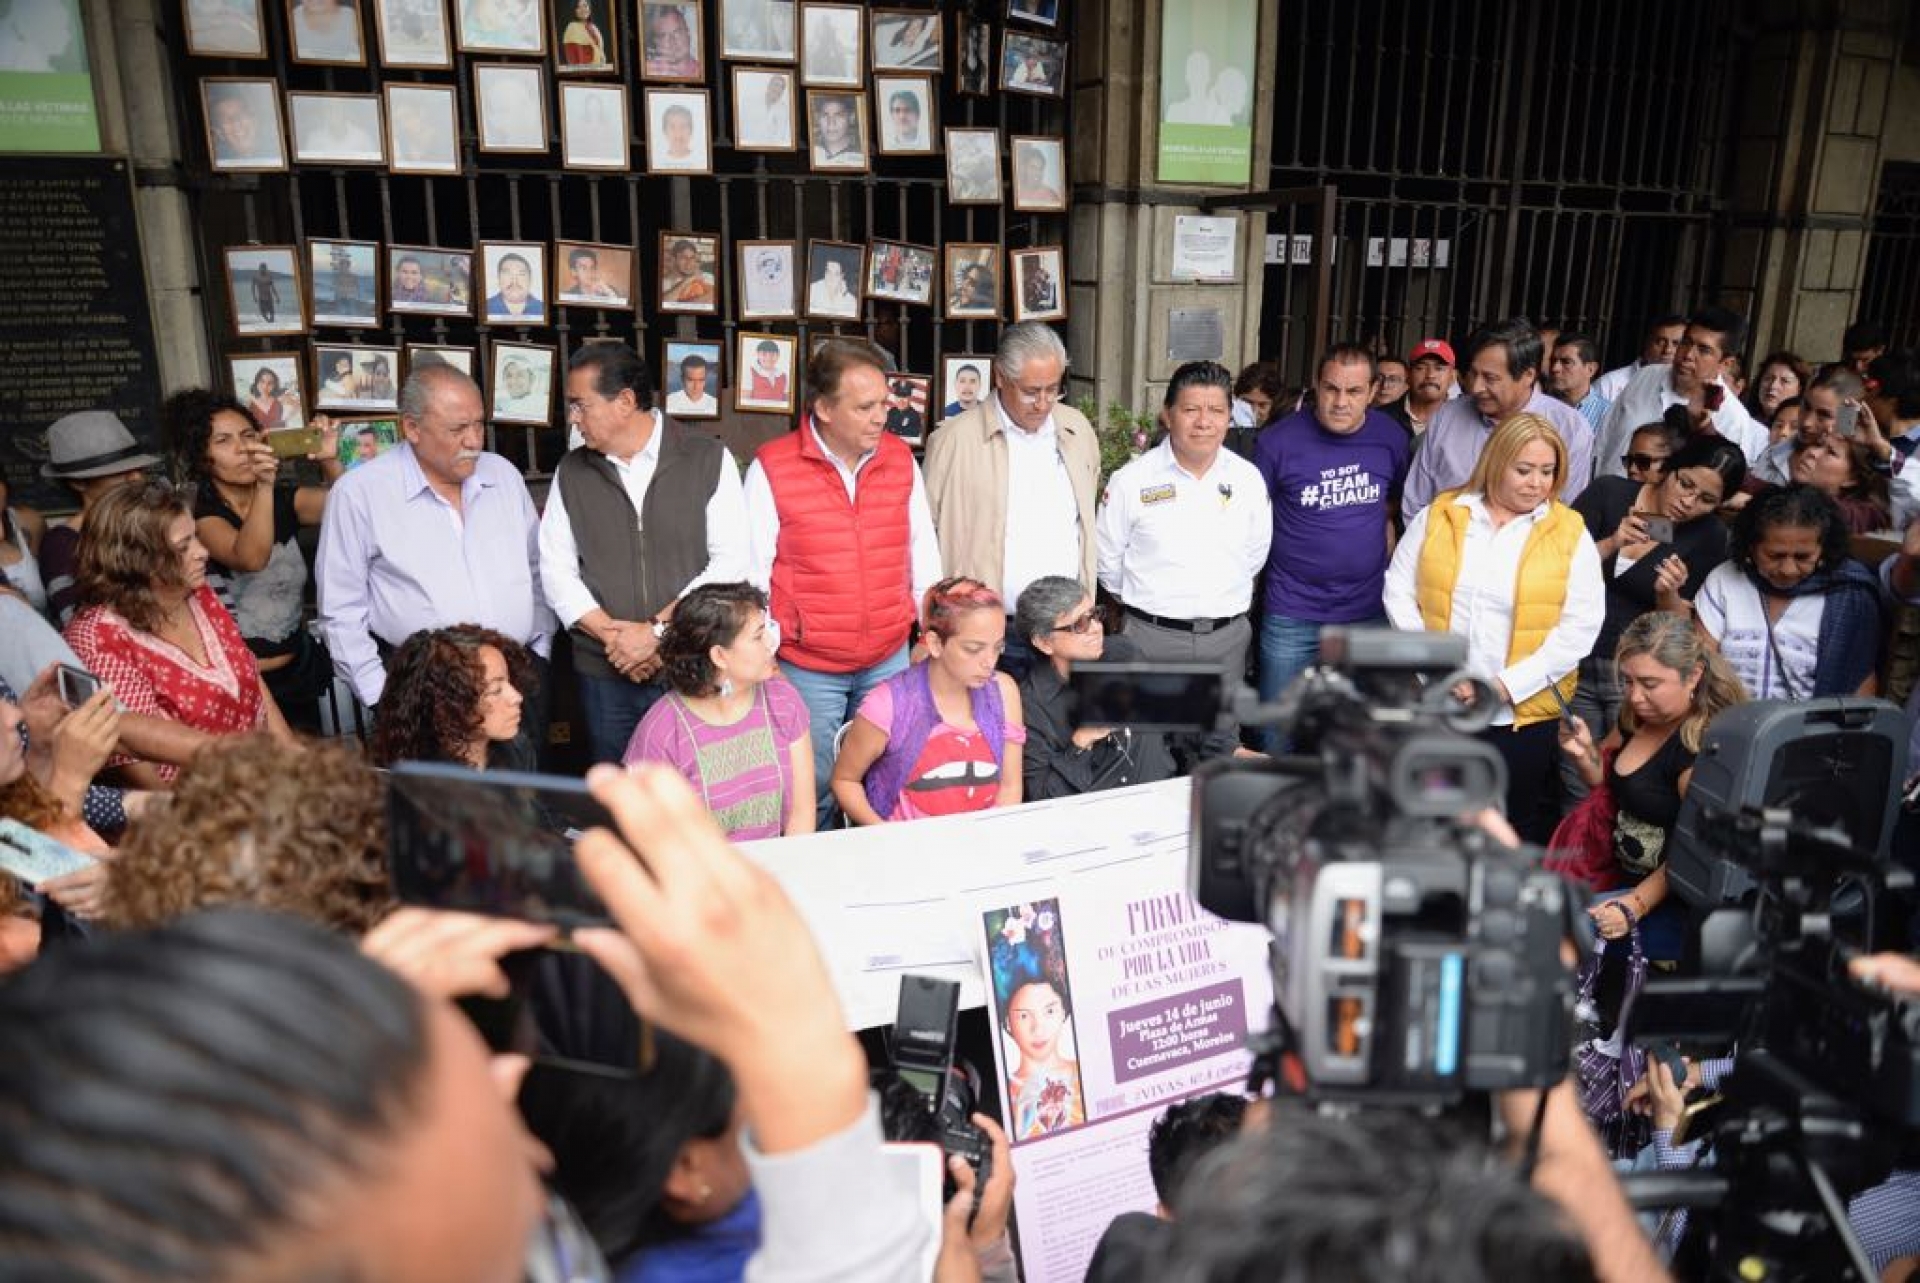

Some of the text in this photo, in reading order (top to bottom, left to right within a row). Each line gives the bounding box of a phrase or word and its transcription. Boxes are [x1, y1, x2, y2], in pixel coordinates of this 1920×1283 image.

[1320, 463, 1360, 479] YO SOY
[1320, 483, 1379, 508] CUAUH
[1098, 919, 1229, 960] DE COMPROMISOS
[1123, 938, 1210, 979] POR LA VIDA
[1111, 961, 1227, 999] DE LAS MUJERES
[1119, 993, 1233, 1038] Jueves 14 de junio
[1139, 1012, 1218, 1042] Plaza de Armas
[1153, 1027, 1209, 1051] 12:00 horas
[1192, 1032, 1235, 1052] Morelos
